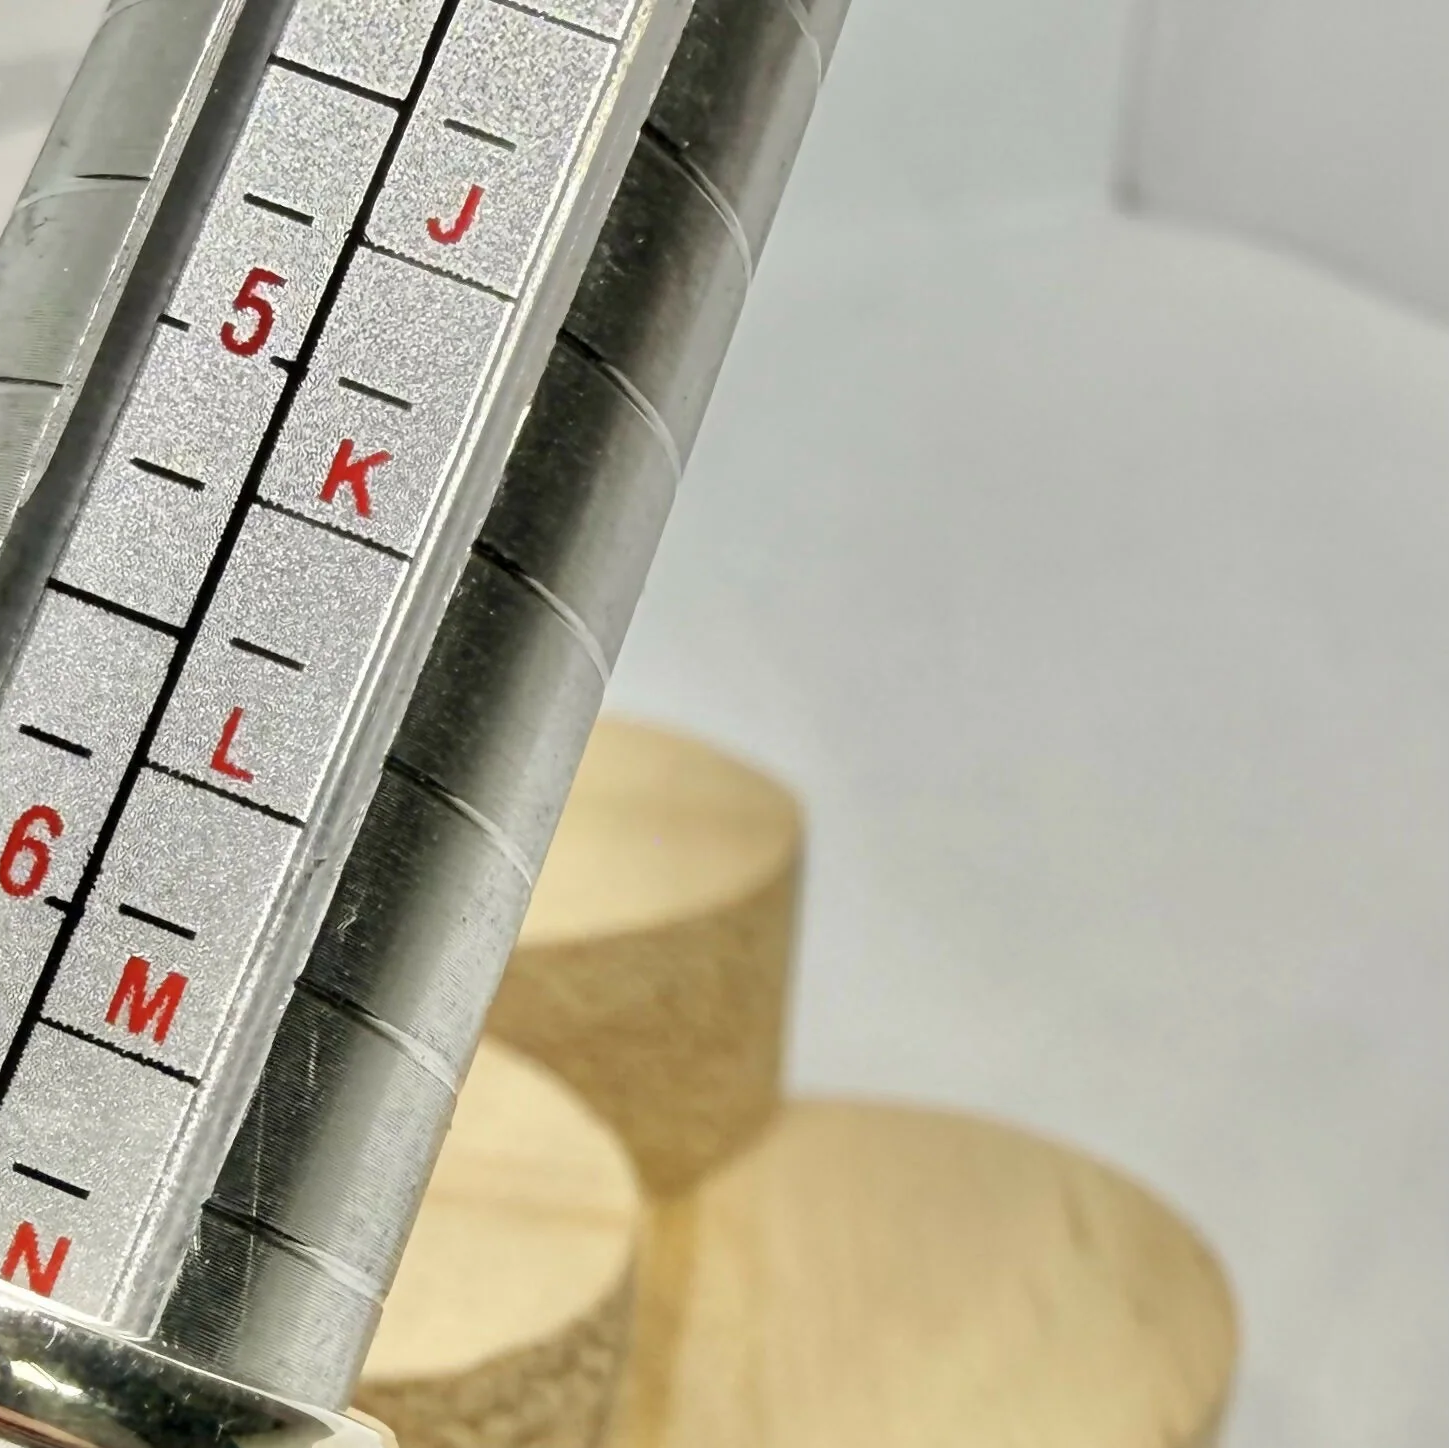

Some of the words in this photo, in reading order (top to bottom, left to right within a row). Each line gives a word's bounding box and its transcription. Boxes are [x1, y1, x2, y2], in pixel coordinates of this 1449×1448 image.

[426, 184, 482, 244] J
[221, 267, 283, 357] 5
[319, 440, 390, 517] K
[209, 708, 252, 782] L
[106, 957, 187, 1043] M
[0, 1221, 72, 1297] N
